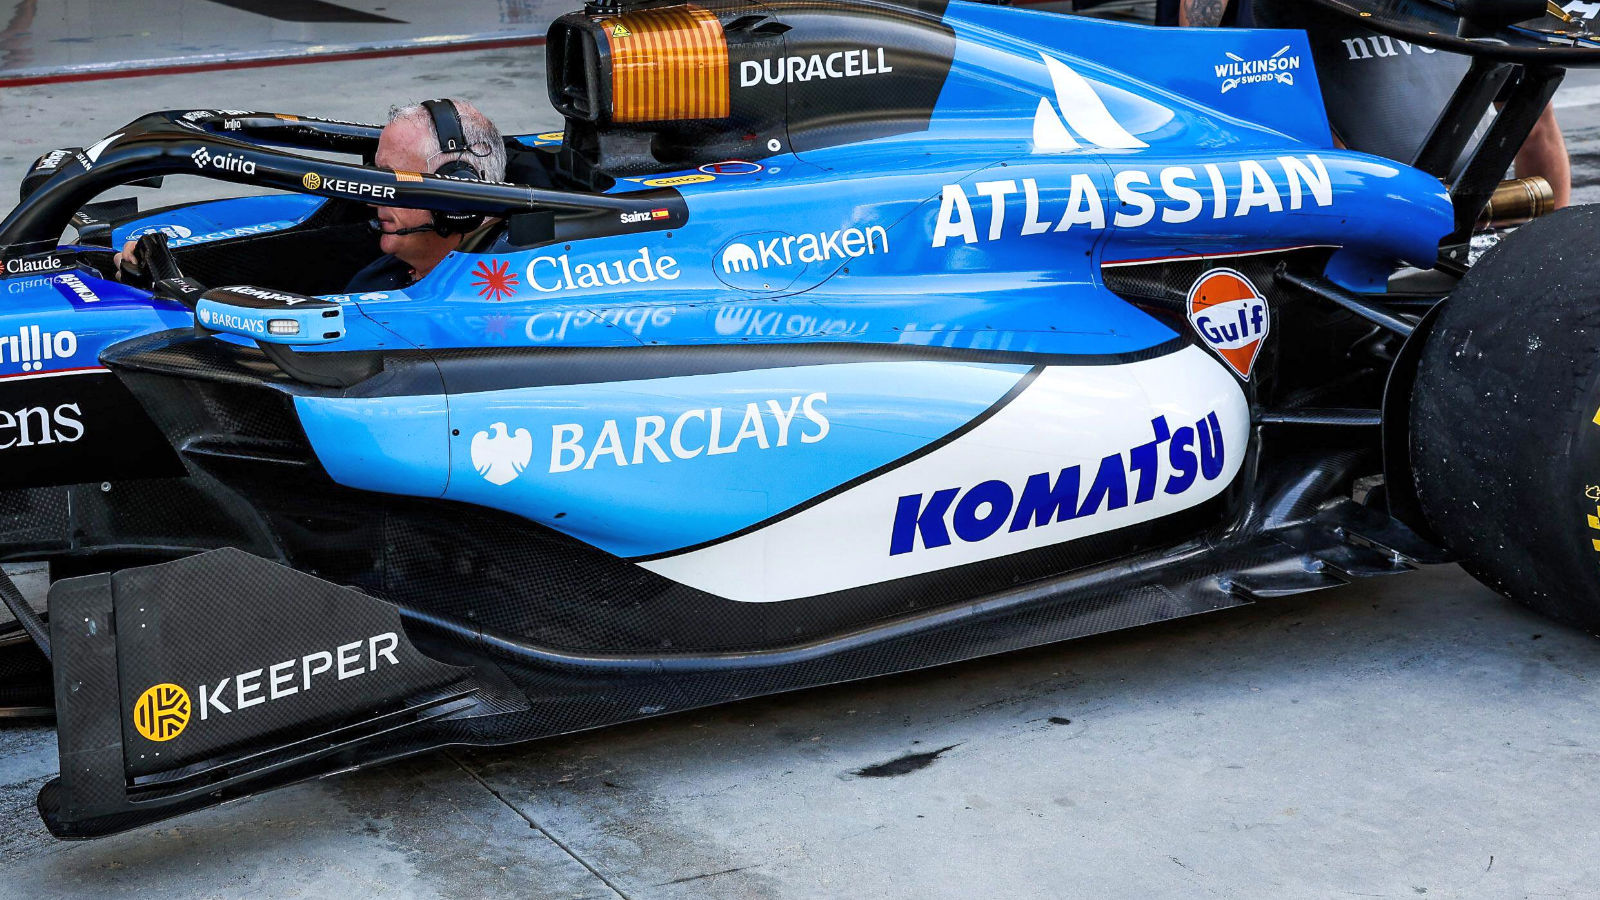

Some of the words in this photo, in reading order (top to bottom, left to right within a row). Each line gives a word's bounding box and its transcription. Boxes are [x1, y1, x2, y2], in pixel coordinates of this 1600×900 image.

[739, 47, 893, 87] DURACELL
[1215, 56, 1300, 78] WILKINSON
[1241, 73, 1274, 84] SWORD
[213, 153, 256, 175] airia
[322, 177, 396, 199] KEEPER
[931, 154, 1334, 248] ATLASSIAN
[620, 211, 651, 224] Sainz
[167, 224, 278, 248] ARCLAYS
[758, 225, 889, 268] Kraken
[6, 255, 62, 273] Claude
[526, 246, 681, 293] Claude
[212, 311, 264, 334] BARCLAYS
[1196, 303, 1264, 345] Gulf
[548, 391, 831, 473] BARCLAYS
[889, 410, 1225, 556] KOMATSU
[198, 631, 401, 721] KEEPER
